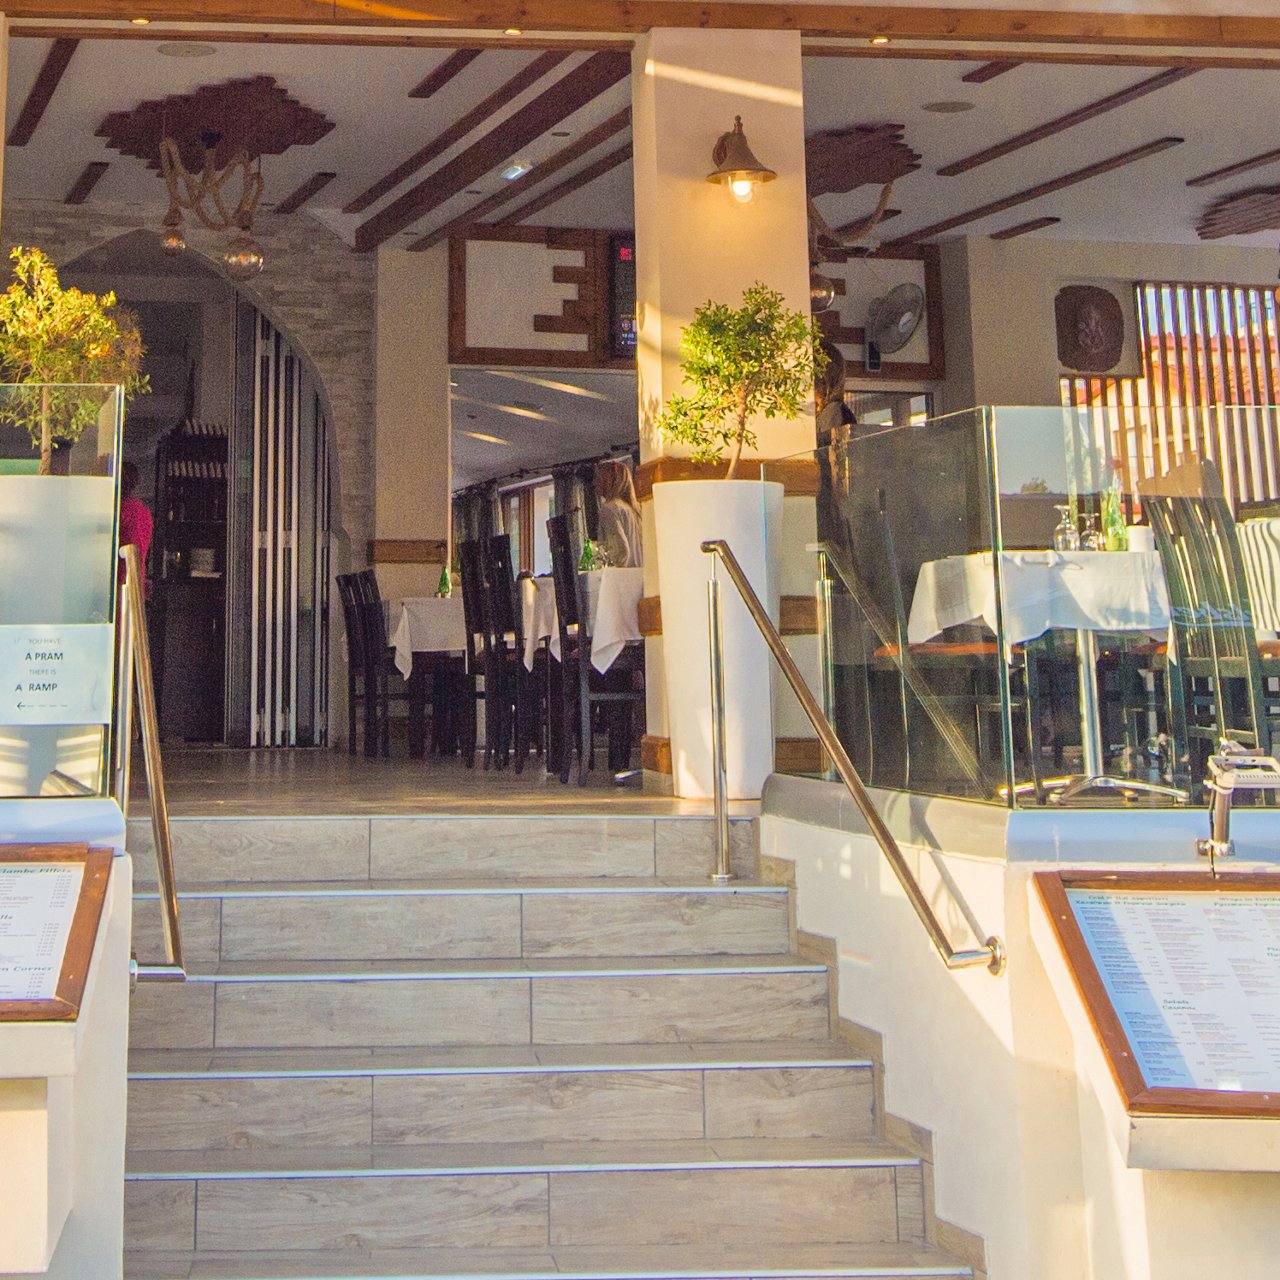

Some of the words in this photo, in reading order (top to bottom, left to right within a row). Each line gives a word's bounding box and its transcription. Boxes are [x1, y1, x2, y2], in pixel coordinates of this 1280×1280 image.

[25, 652, 32, 661] A
[35, 652, 63, 661] PRAM
[15, 683, 22, 692] A
[29, 683, 58, 692] RAMP
